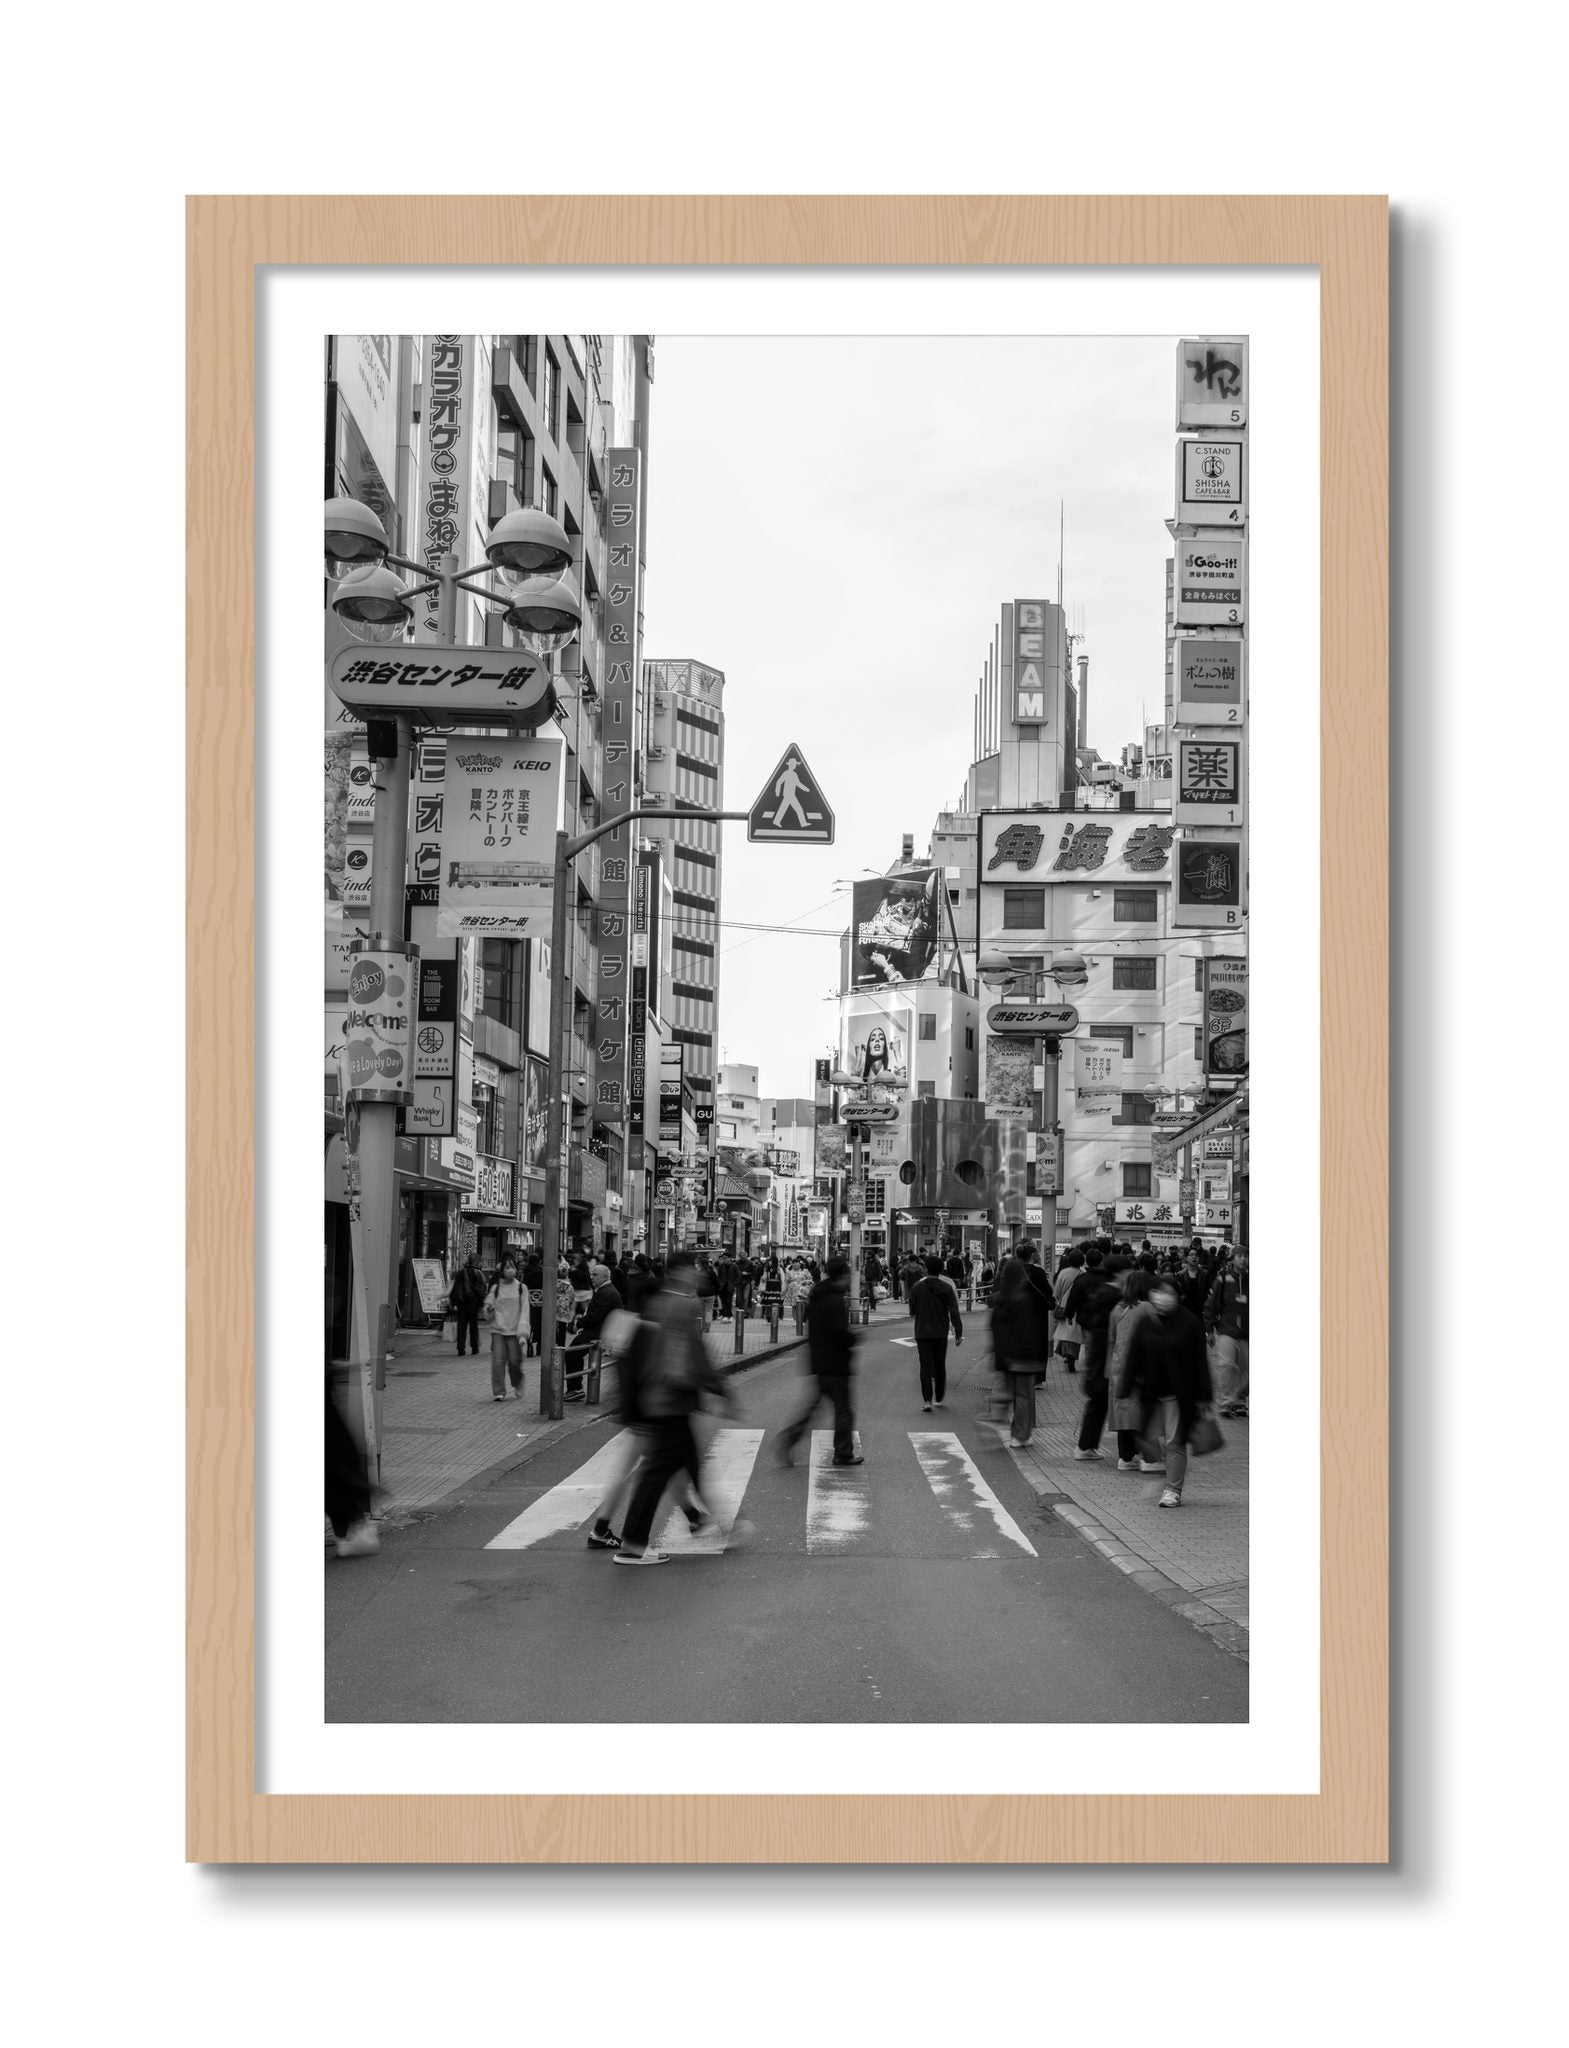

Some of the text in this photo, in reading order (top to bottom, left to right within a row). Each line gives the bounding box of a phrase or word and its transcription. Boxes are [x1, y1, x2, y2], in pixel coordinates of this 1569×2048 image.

[430, 343, 463, 453] カラオケ
[1230, 409, 1240, 422] 5
[1195, 479, 1231, 488] SHISHA
[1194, 556, 1238, 569] Goo-it!
[1185, 591, 1239, 601] 全身もみほぐし
[1228, 609, 1238, 622] 3
[1018, 603, 1045, 717] BEAM
[340, 660, 536, 690] 渋谷センター街
[1228, 709, 1238, 721] 2
[513, 760, 552, 771] KEIO
[1187, 747, 1229, 788] 薬
[1183, 790, 1233, 801] マツモトキヨシ
[469, 788, 482, 823] 冒険へ
[517, 789, 531, 836] 京王線で
[484, 788, 498, 847] カントーの
[500, 788, 515, 847] ポケパーク
[1227, 809, 1234, 822] 1
[987, 822, 1175, 872] 角海老
[1184, 854, 1232, 892] 一蘭
[637, 870, 646, 898] kimono
[459, 916, 530, 927] 渋谷センター街
[1226, 910, 1236, 924] B
[350, 970, 383, 998] Enjoy
[598, 913, 626, 1104] カラオケ館
[993, 1011, 1073, 1022] 渋谷センター街
[348, 1010, 408, 1030] Welcome
[1209, 1018, 1232, 1034] 6F
[362, 1056, 385, 1072] Lovely
[414, 1107, 440, 1117] Whisky
[697, 1110, 713, 1119] GU
